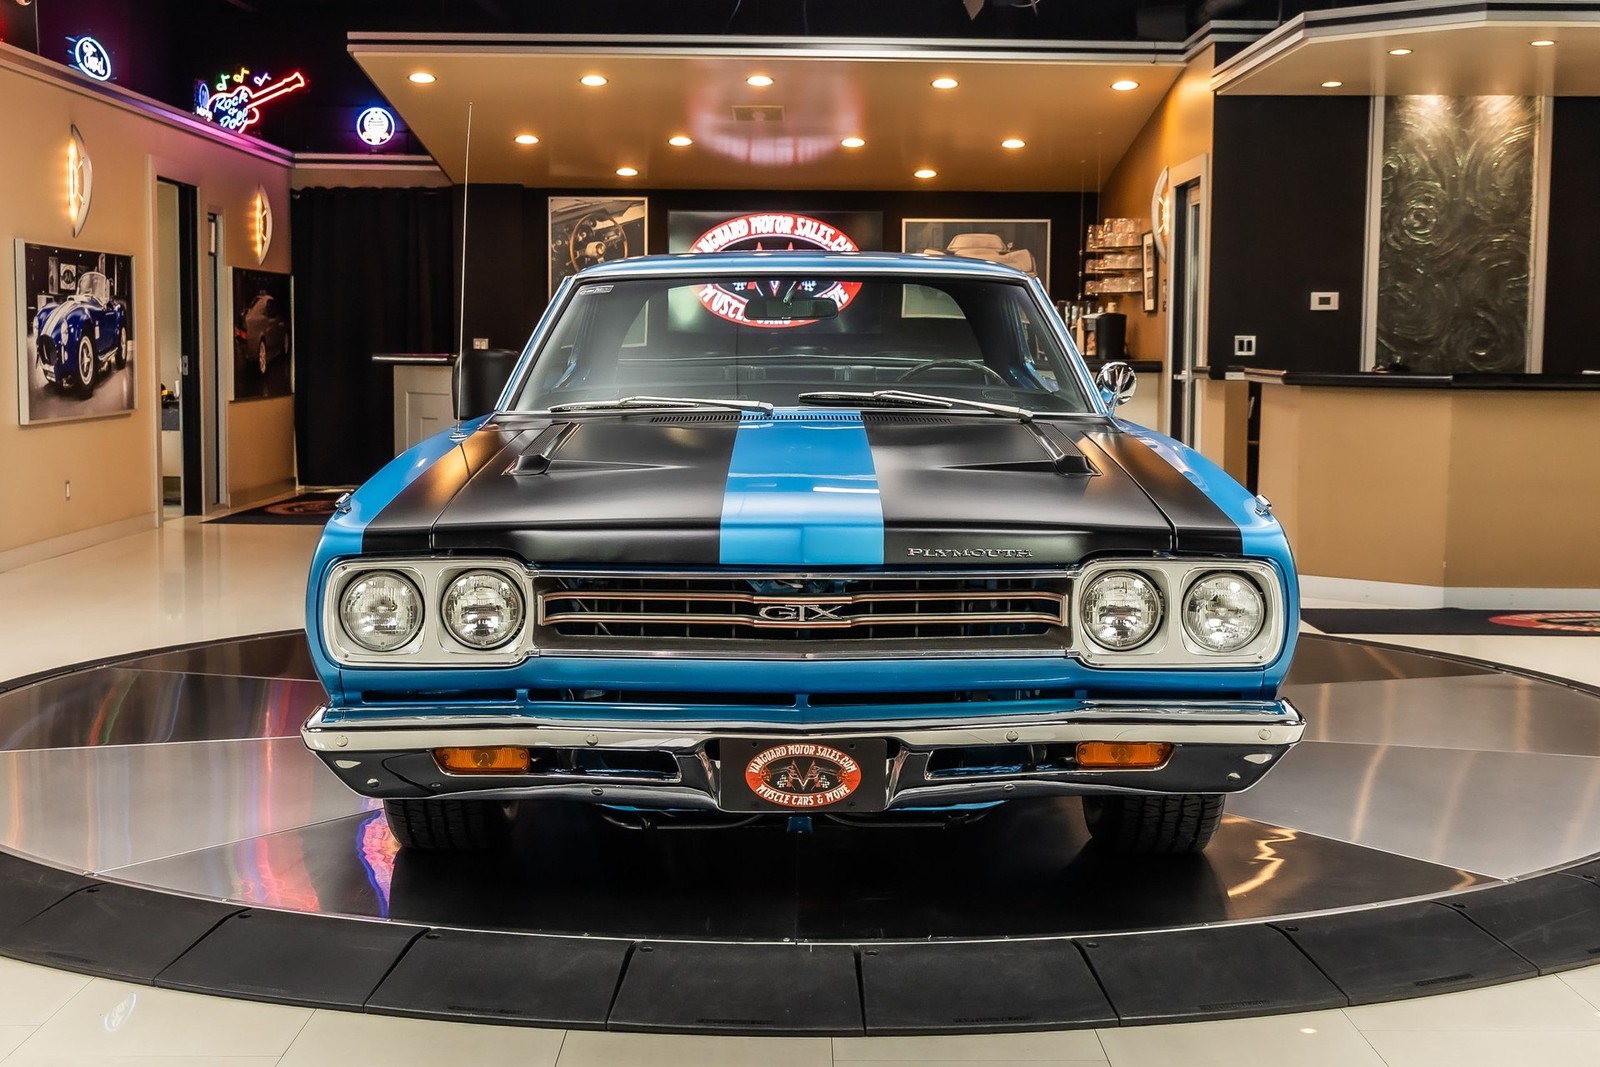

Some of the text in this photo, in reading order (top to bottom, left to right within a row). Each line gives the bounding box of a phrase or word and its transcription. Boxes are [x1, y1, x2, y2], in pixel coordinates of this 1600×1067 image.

[213, 88, 249, 113] Rock
[692, 215, 856, 252] NGUARD MOTOR SALES.CO
[698, 283, 751, 322] MUSCL
[906, 547, 1034, 559] PLYMOUTH
[758, 604, 845, 622] GTX
[748, 744, 857, 774] VANGUARD MOTOR SALES.COM
[755, 783, 851, 806] MUSCLE CARS & MORE
